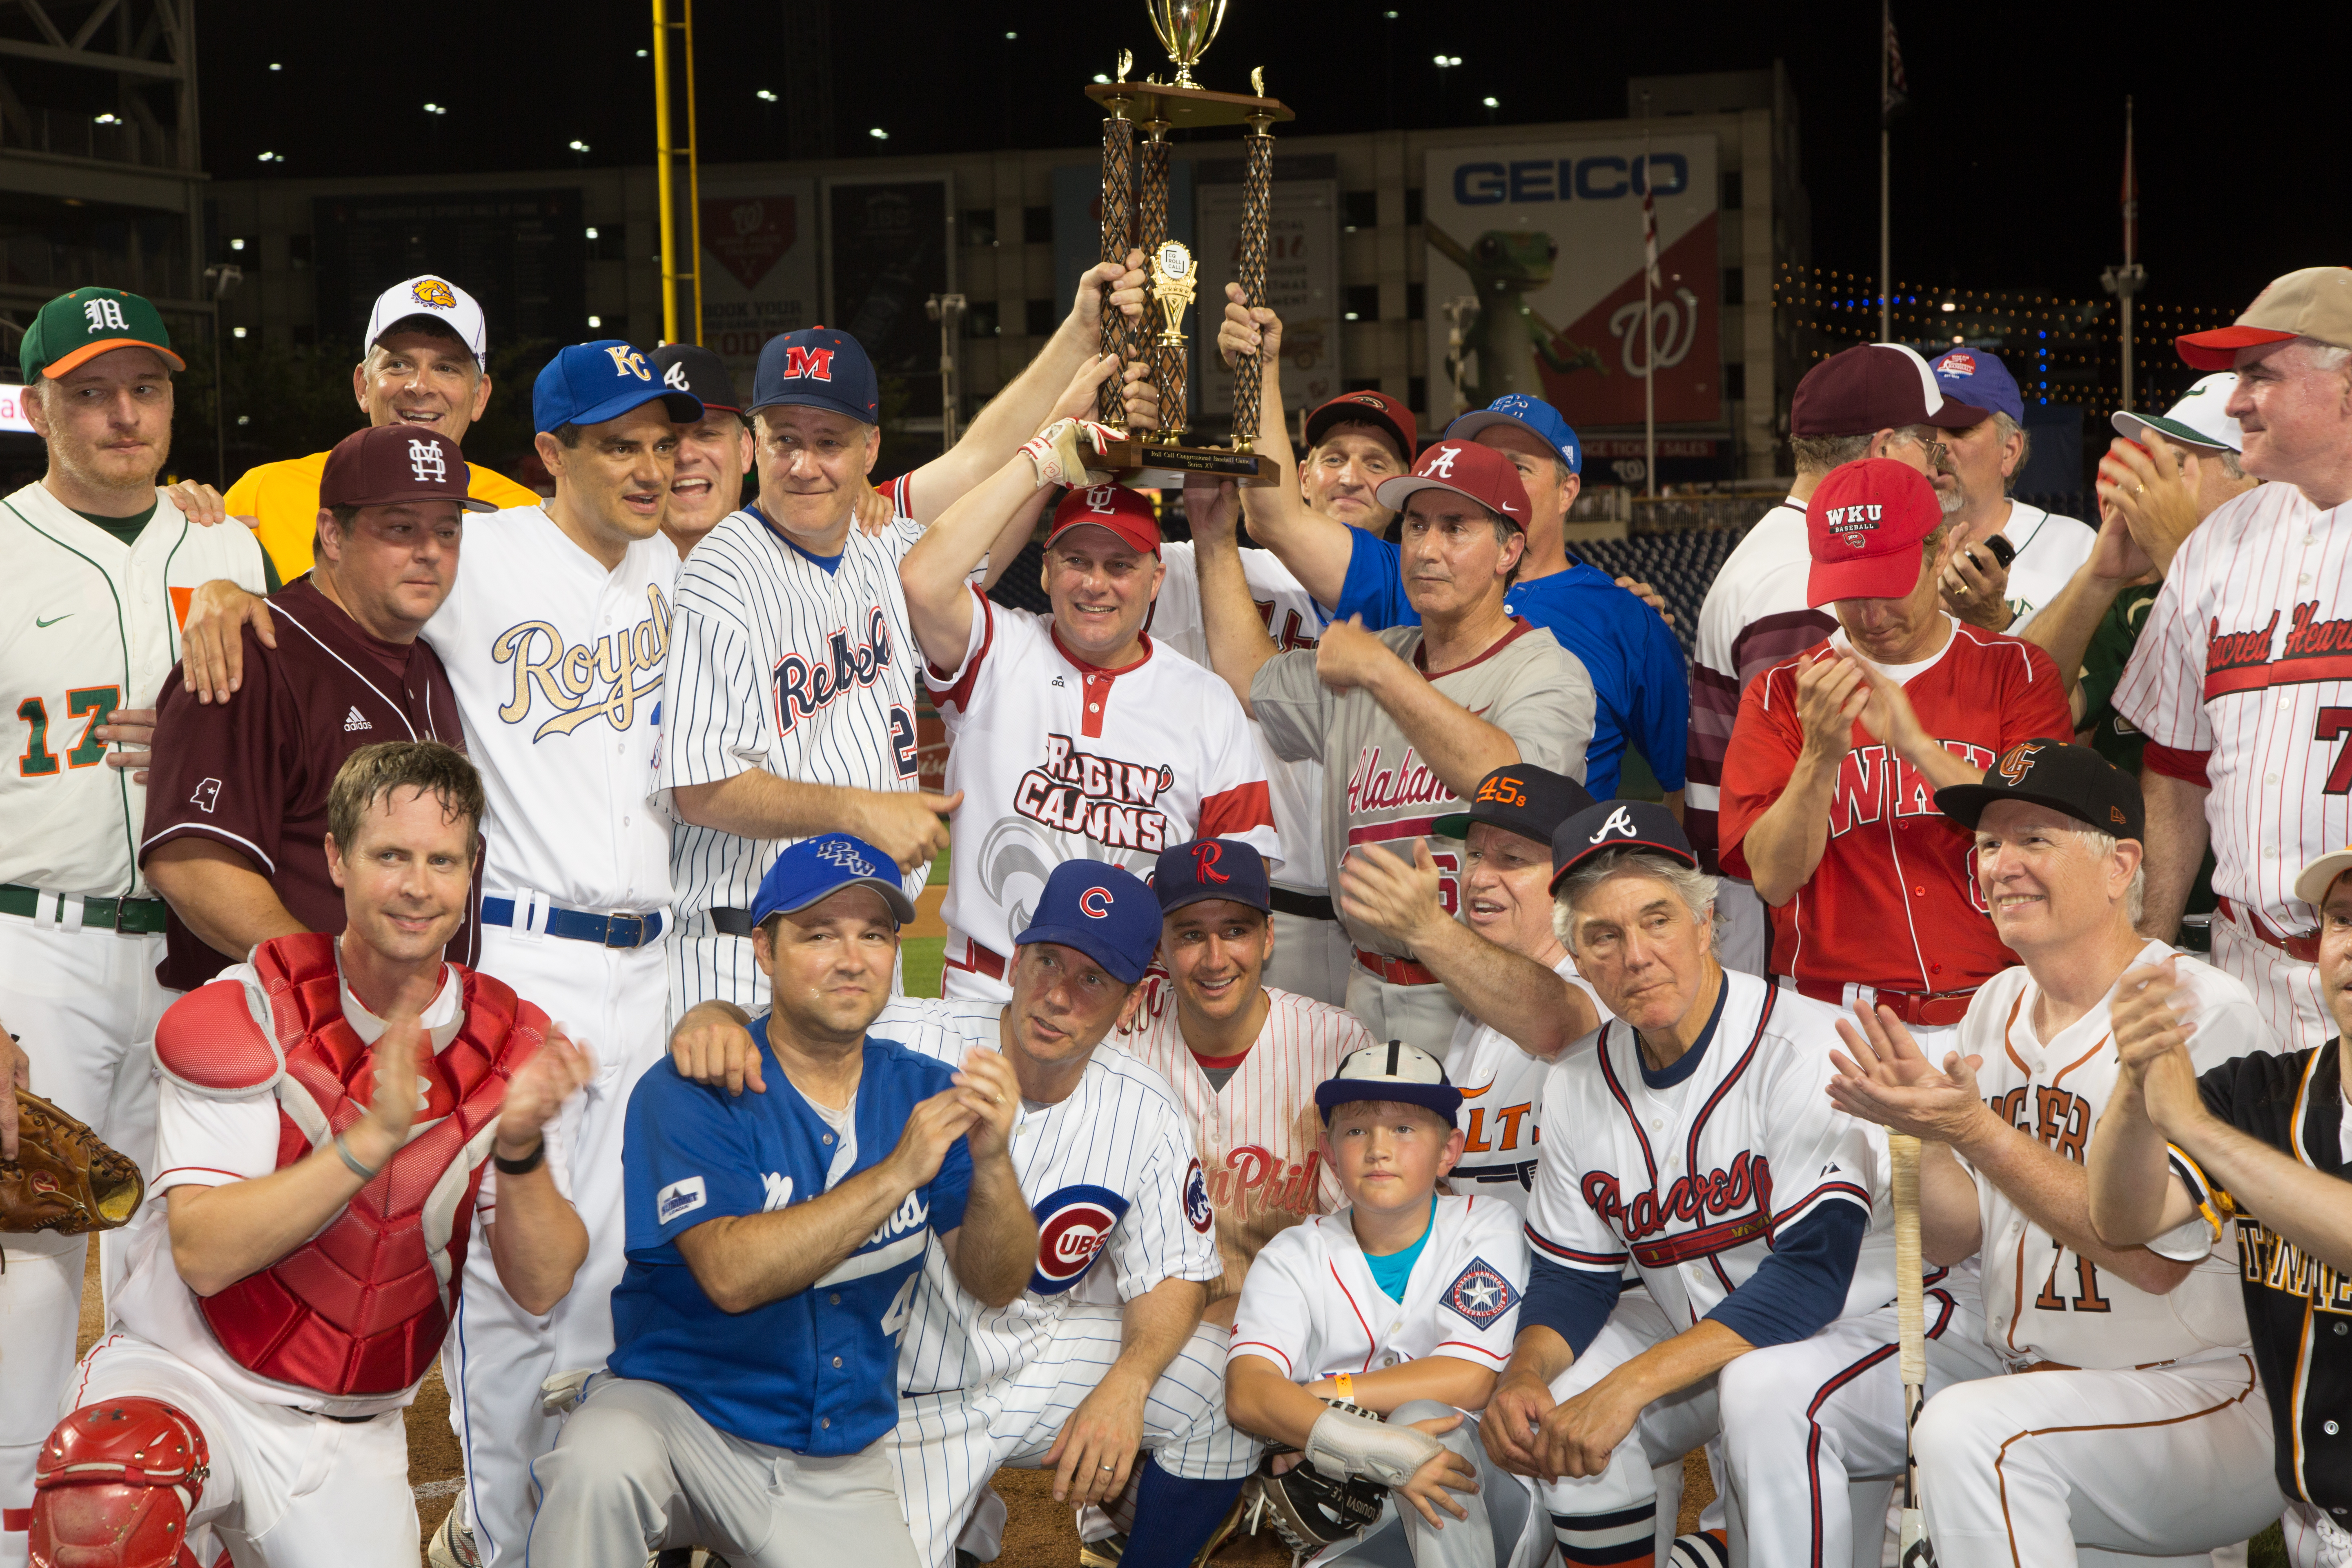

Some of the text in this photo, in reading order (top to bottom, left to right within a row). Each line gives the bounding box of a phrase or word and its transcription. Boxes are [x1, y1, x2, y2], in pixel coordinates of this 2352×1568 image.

[1454, 154, 1688, 205] GEICO
[1609, 287, 1698, 379] W
[605, 345, 651, 381] KC
[663, 362, 690, 391] A
[784, 346, 834, 383] M
[1176, 453, 1211, 461] Congressional
[1418, 446, 1462, 479] A
[1611, 441, 1660, 457] TICKT
[1664, 441, 1708, 455] SALES
[1085, 486, 1117, 514] UL
[1826, 504, 1882, 526] WKU
[1835, 523, 1874, 533] BASEBALL
[16, 684, 121, 777] 17
[343, 719, 373, 732] adidas
[890, 703, 918, 780] 2
[1014, 770, 1167, 853] CAJUNS
[1589, 806, 1637, 844] A
[816, 839, 876, 877] IPFW
[1190, 840, 1230, 886] R
[1079, 886, 1114, 919] C
[662, 1191, 699, 1216] SUMMIT
[669, 1204, 690, 1216] LEAGUE
[1580, 1149, 1752, 1241] Braves
[1456, 1272, 1505, 1292] TEXAS RANGERS
[1456, 1300, 1505, 1316] BASEBALL CLUB
